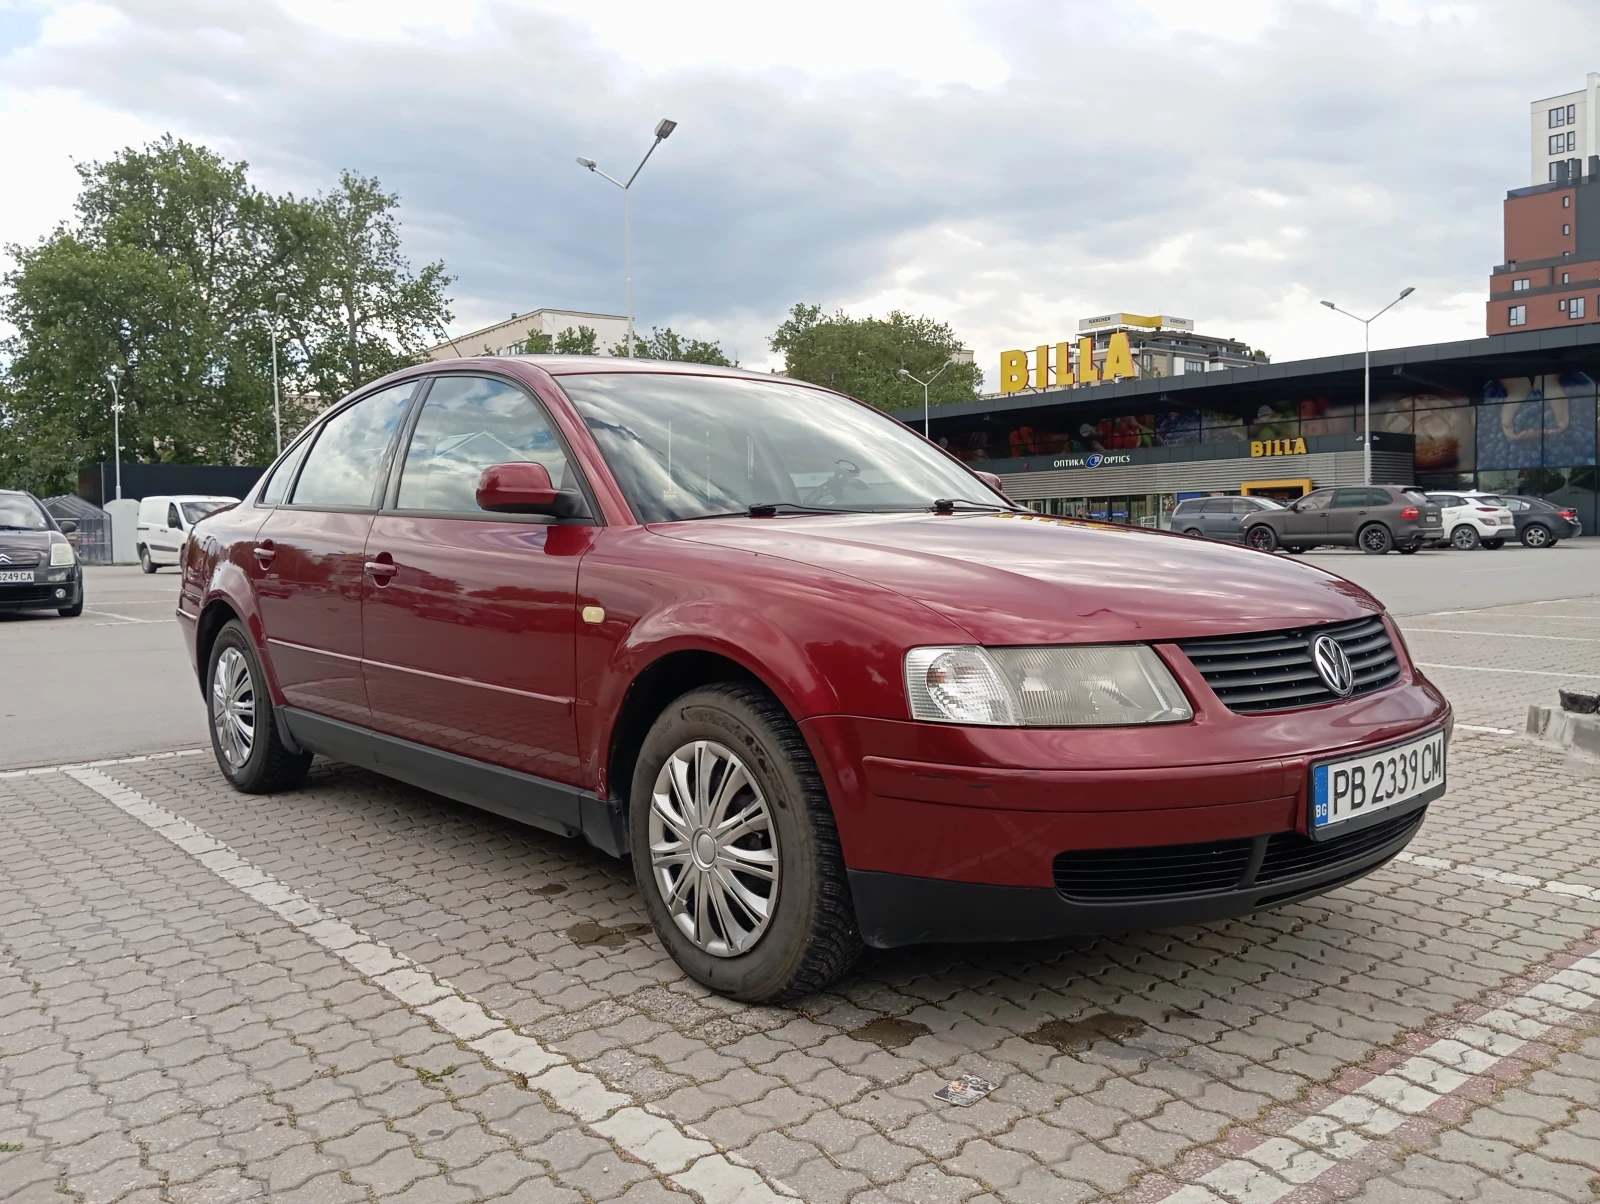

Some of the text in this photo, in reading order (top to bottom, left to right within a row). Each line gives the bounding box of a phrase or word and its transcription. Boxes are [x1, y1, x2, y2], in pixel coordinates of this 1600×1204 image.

[1000, 332, 1136, 393] BILLA
[1250, 437, 1307, 457] BILLA
[1053, 458, 1085, 468] ОПТИКА
[1103, 455, 1131, 464] OPTICS
[20, 572, 33, 581] CA
[1333, 739, 1441, 815] PB 2339 CM
[1315, 803, 1327, 818] BG
